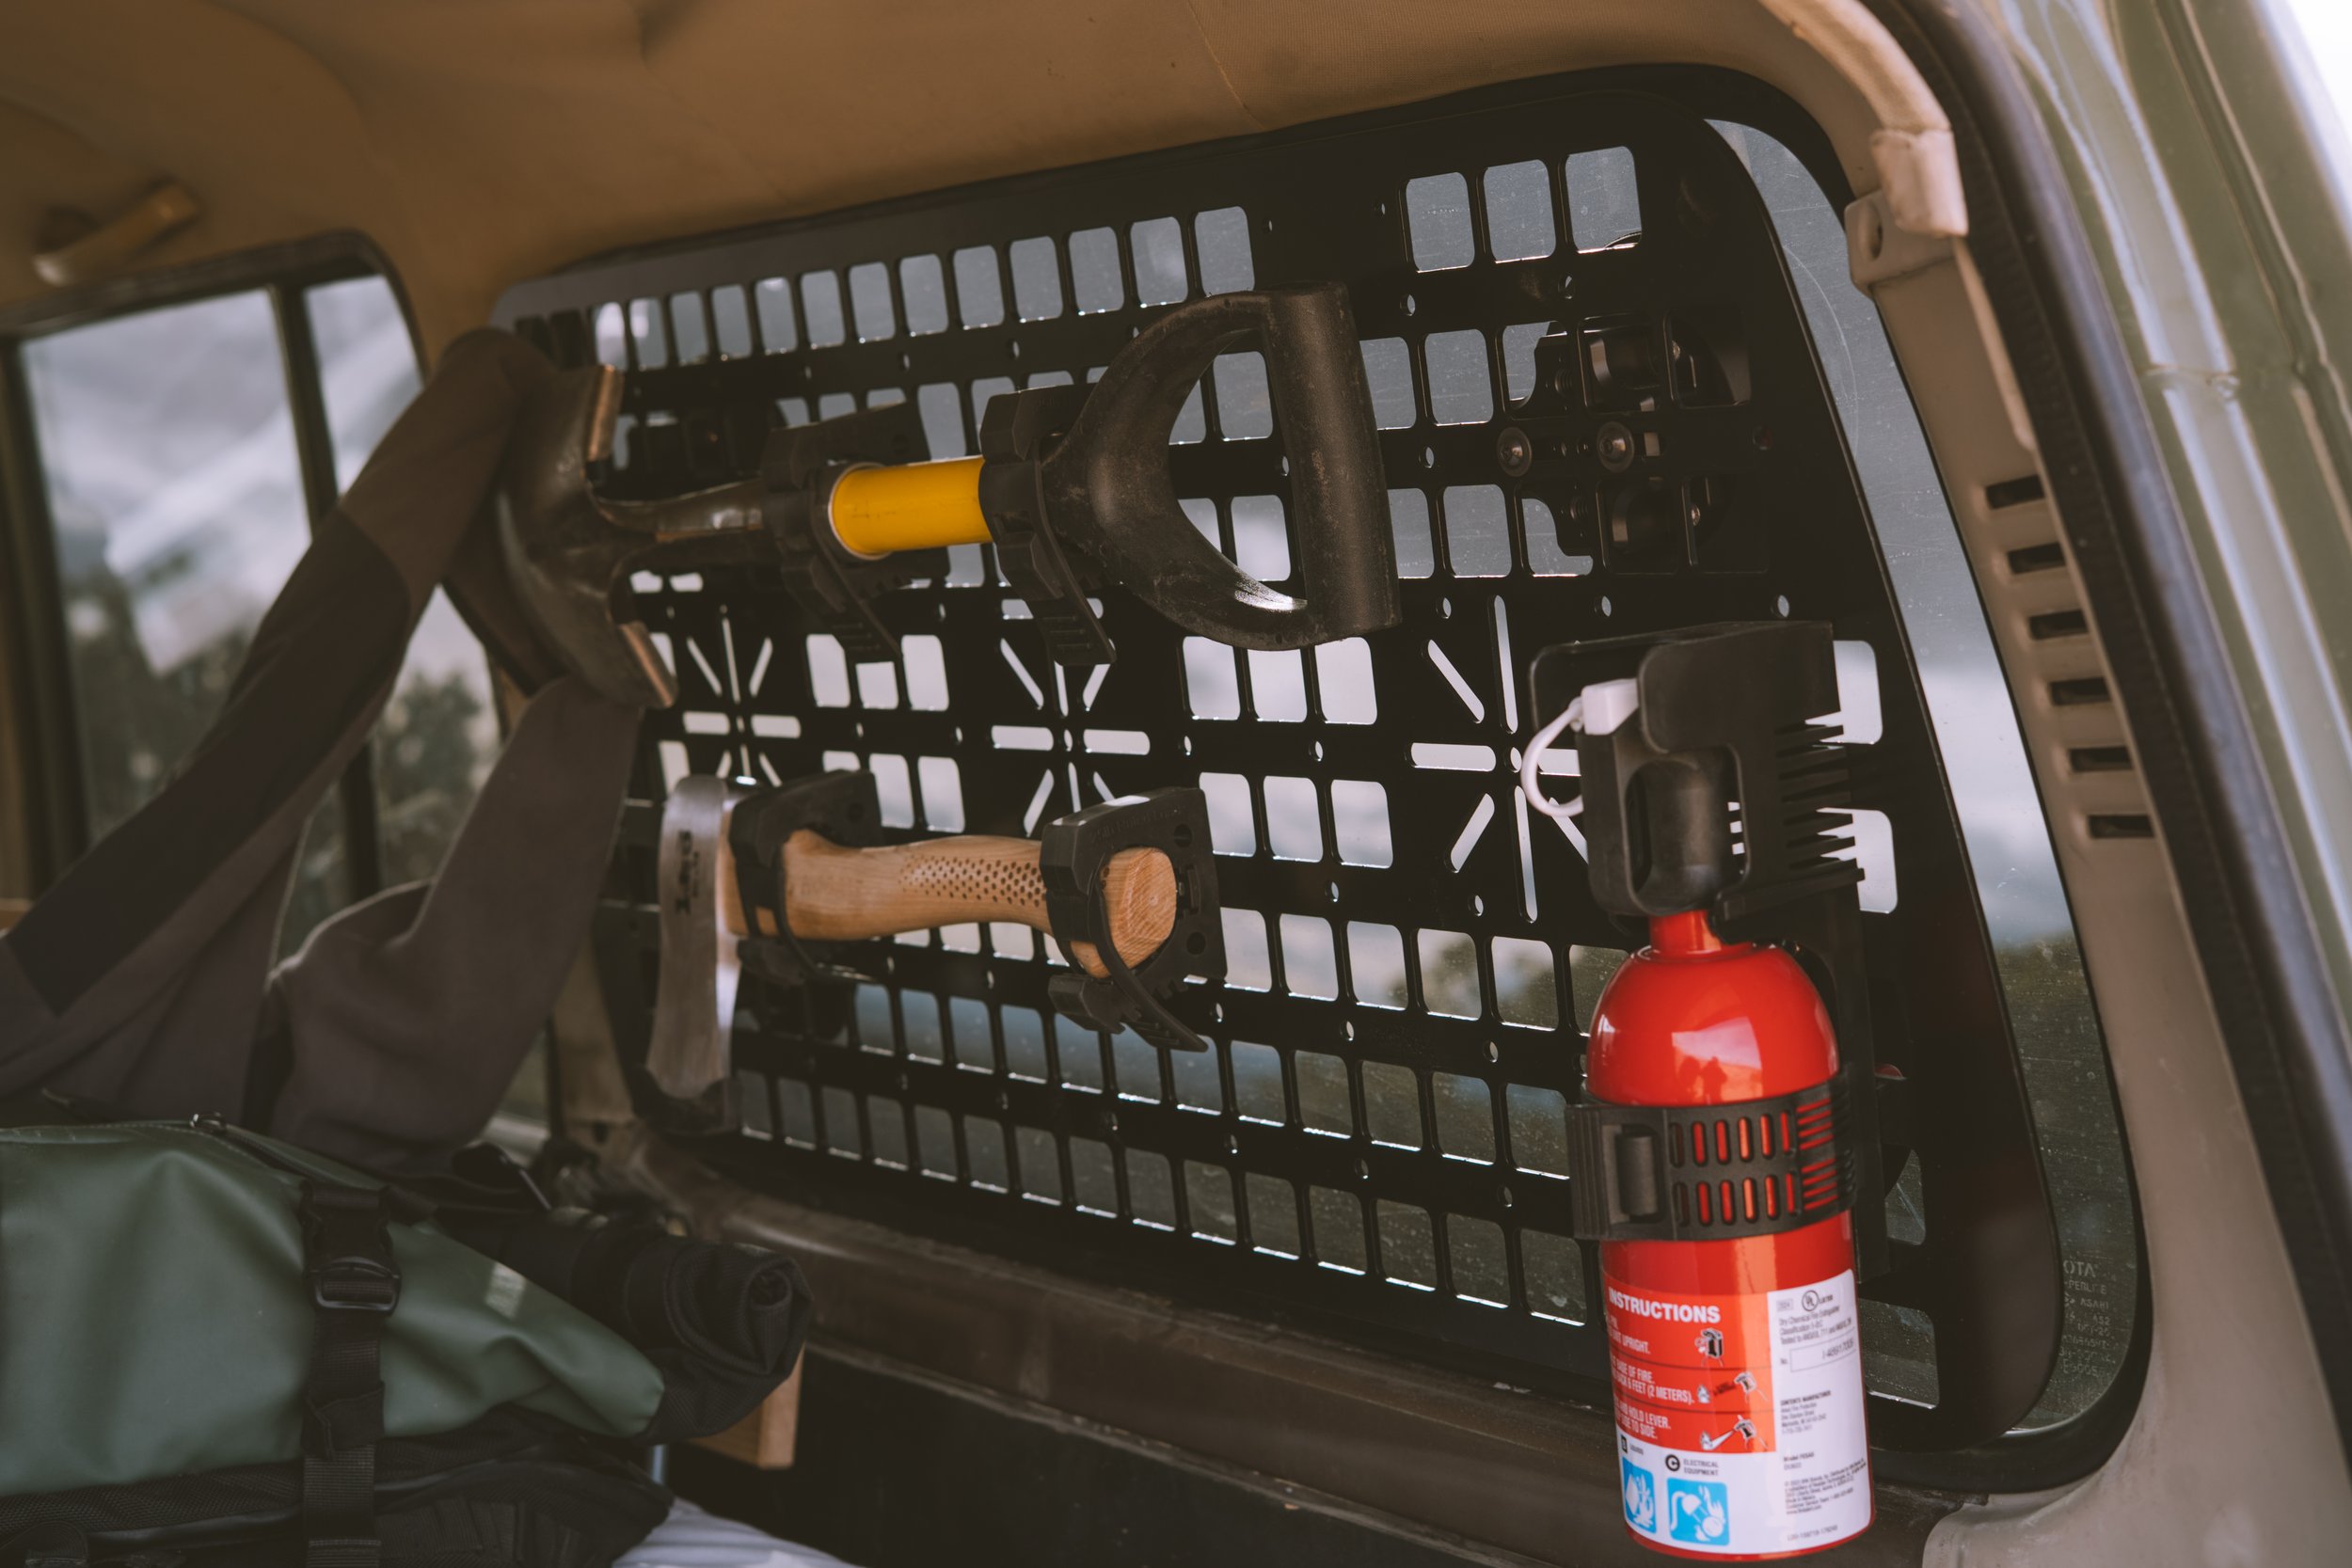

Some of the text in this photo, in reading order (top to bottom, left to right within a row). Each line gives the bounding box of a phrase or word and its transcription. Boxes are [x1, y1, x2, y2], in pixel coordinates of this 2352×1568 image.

[1631, 1379, 1646, 1394] FEET
[1647, 1384, 1656, 1399] (2
[1656, 1386, 1695, 1405] METERS).
[1645, 1412, 1671, 1430] LEVER.
[1683, 1459, 1719, 1467] ELECTRICAL
[1683, 1467, 1719, 1476] EQUIPMENT
